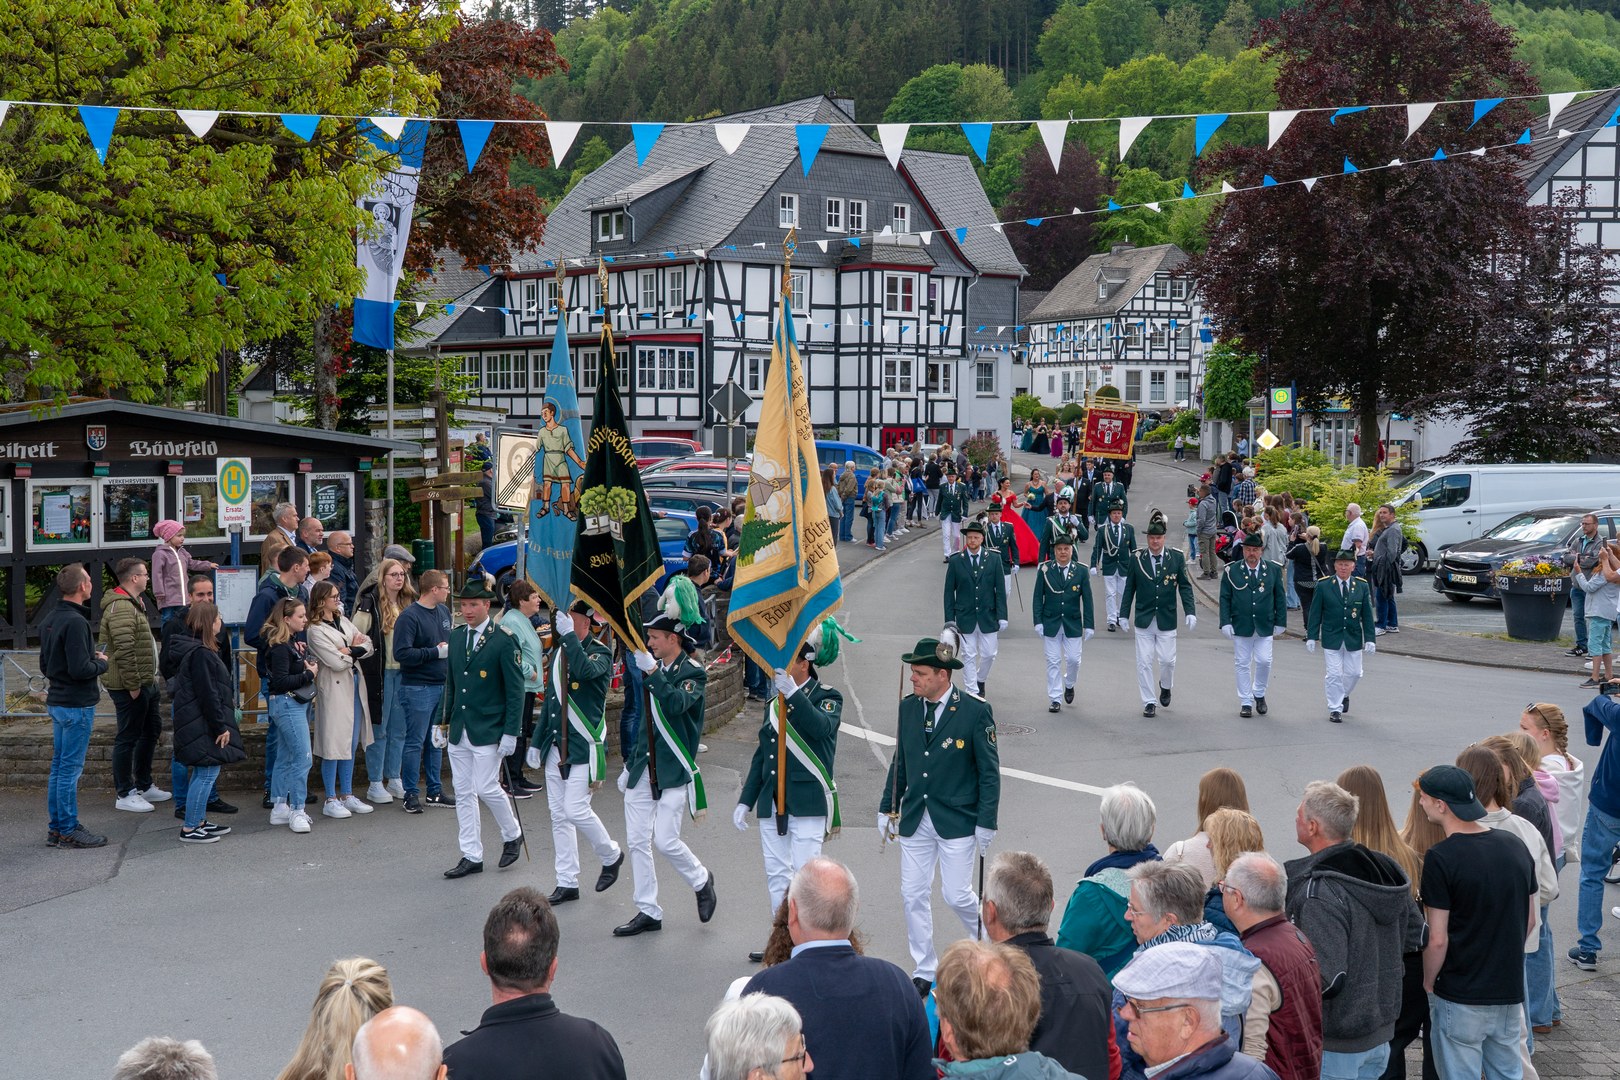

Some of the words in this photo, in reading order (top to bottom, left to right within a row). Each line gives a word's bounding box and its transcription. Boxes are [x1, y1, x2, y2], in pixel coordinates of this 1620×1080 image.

[919, 431, 924, 441] 3
[129, 440, 219, 458] Bödefeld
[227, 471, 242, 495] H
[1533, 584, 1562, 592] Bödefeld
